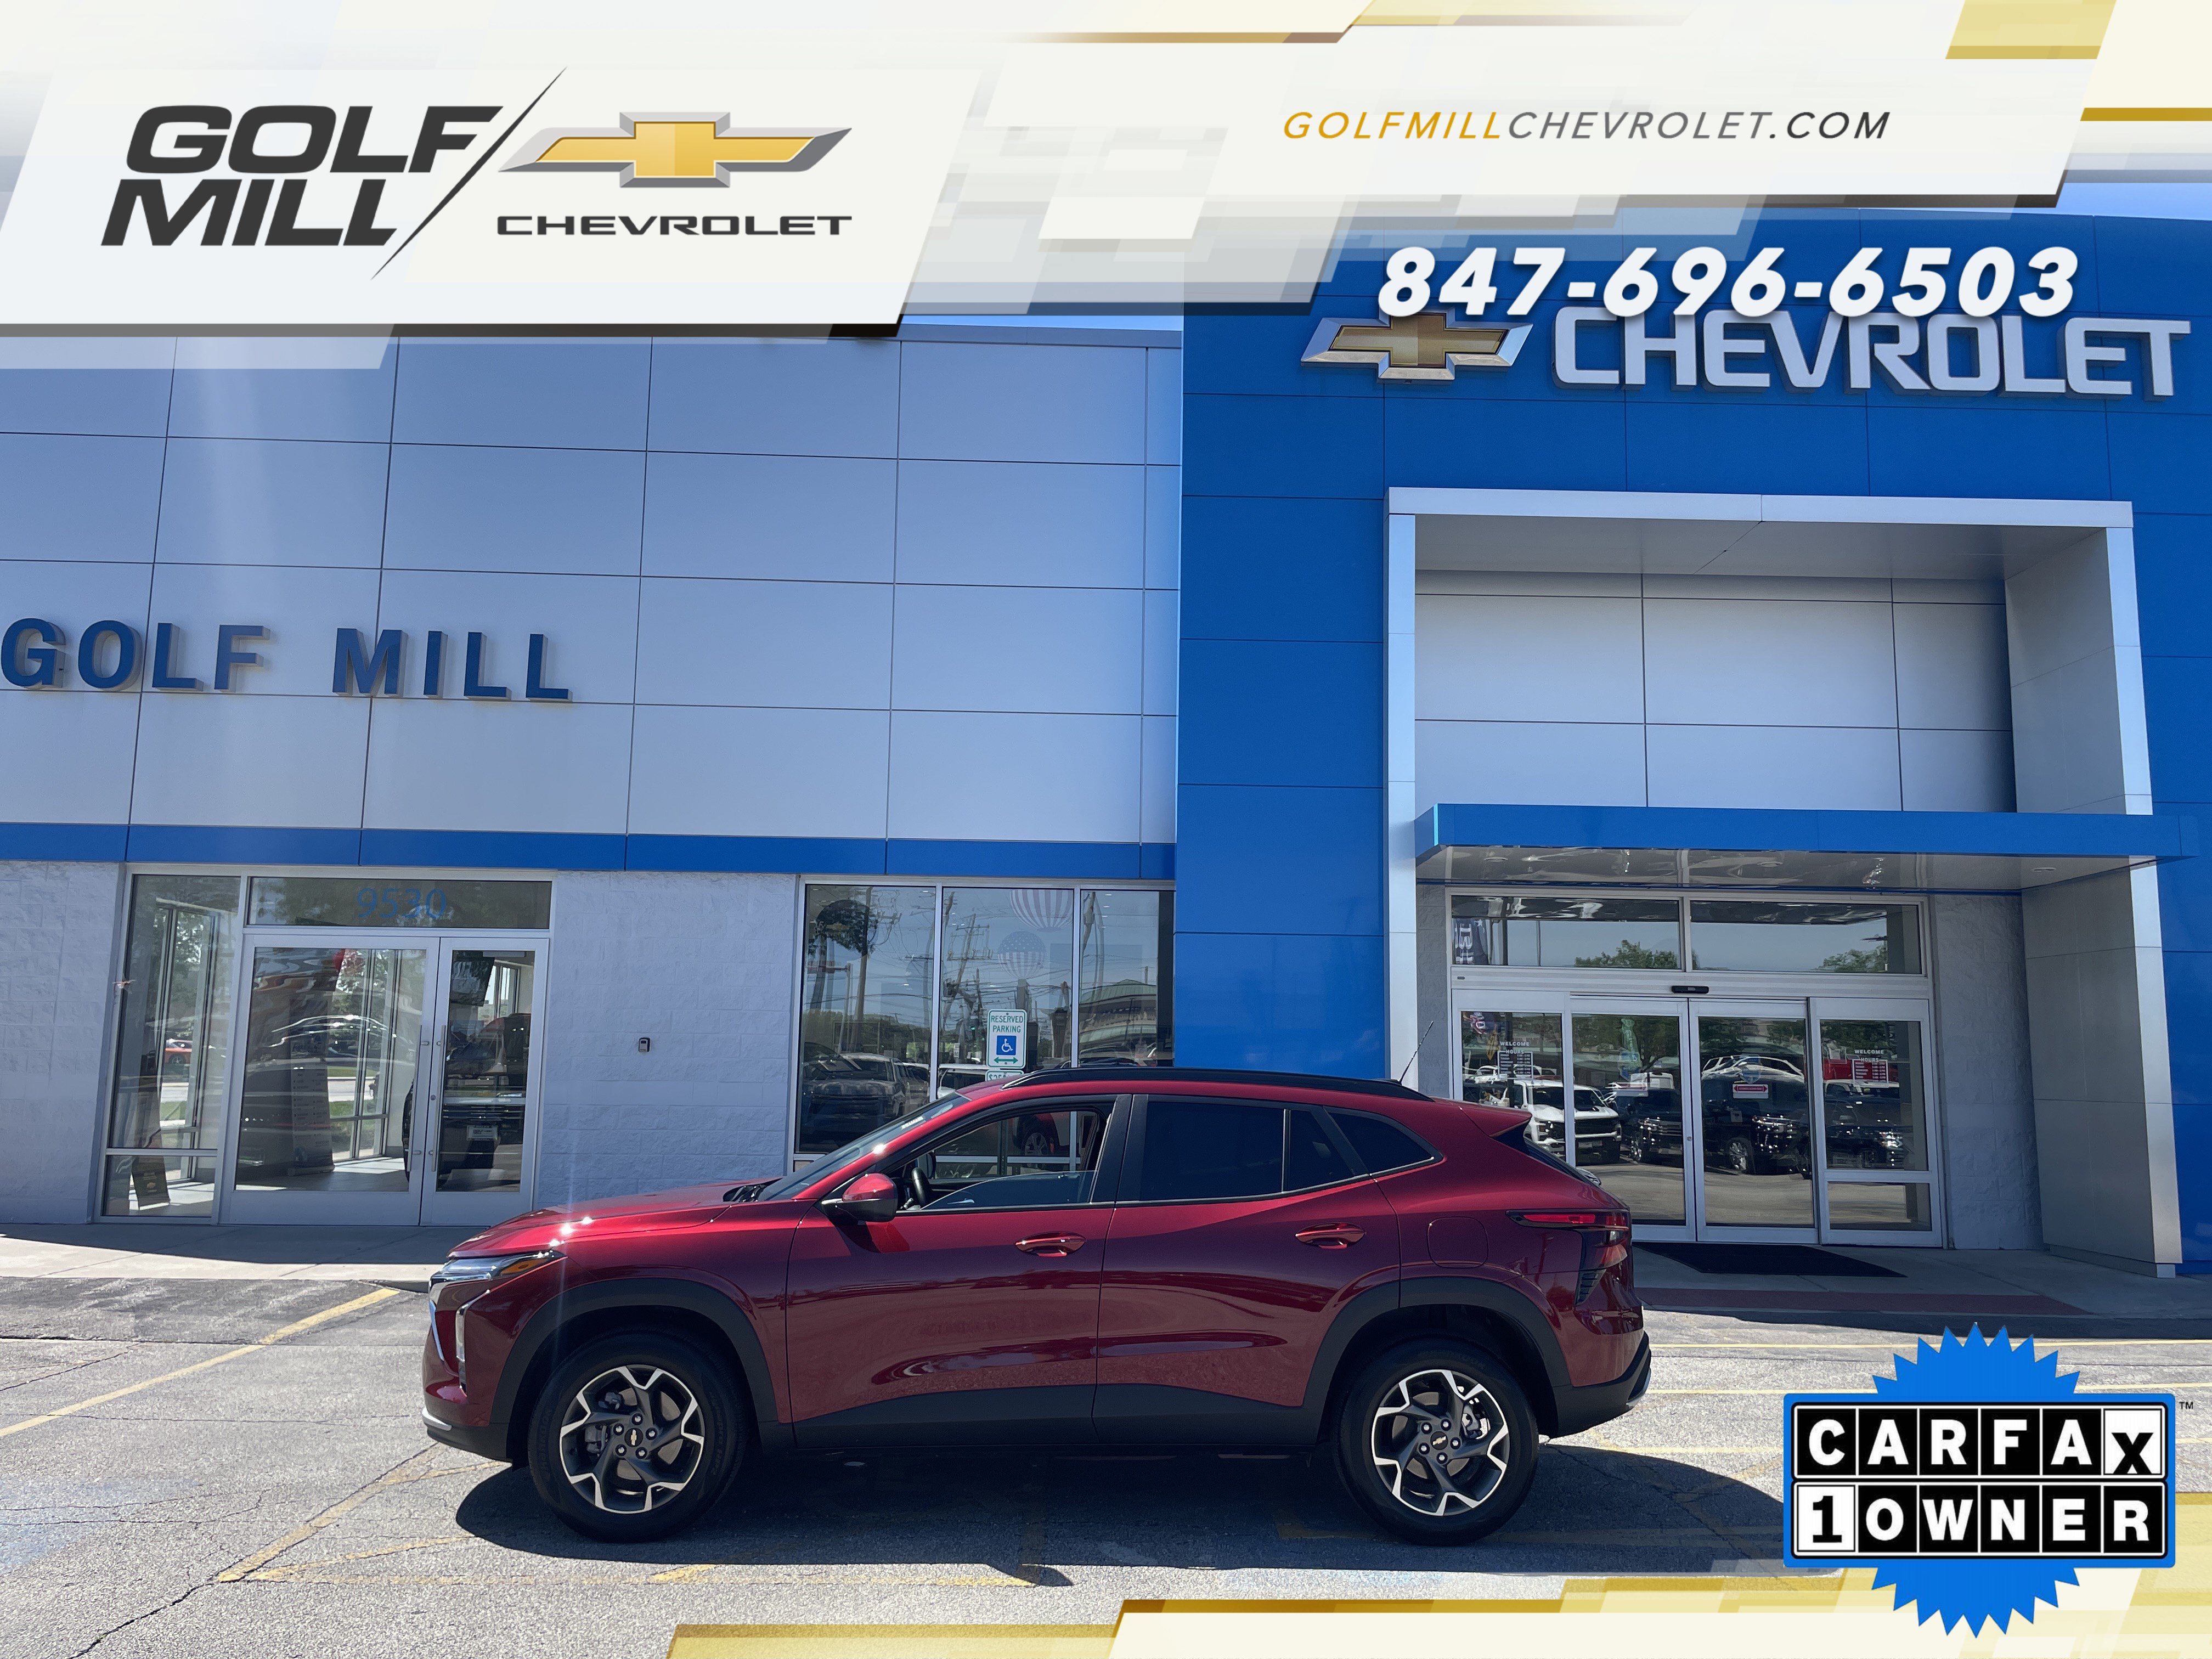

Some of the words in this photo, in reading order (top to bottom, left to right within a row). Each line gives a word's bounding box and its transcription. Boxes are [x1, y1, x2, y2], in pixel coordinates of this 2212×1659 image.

[1555, 305, 2191, 397] CHEVROLET
[1, 618, 269, 691] GOLF
[332, 628, 571, 700] MILL
[357, 888, 447, 918] 9530
[990, 1015, 1024, 1023] RESERVED
[992, 1025, 1022, 1033] PARKING
